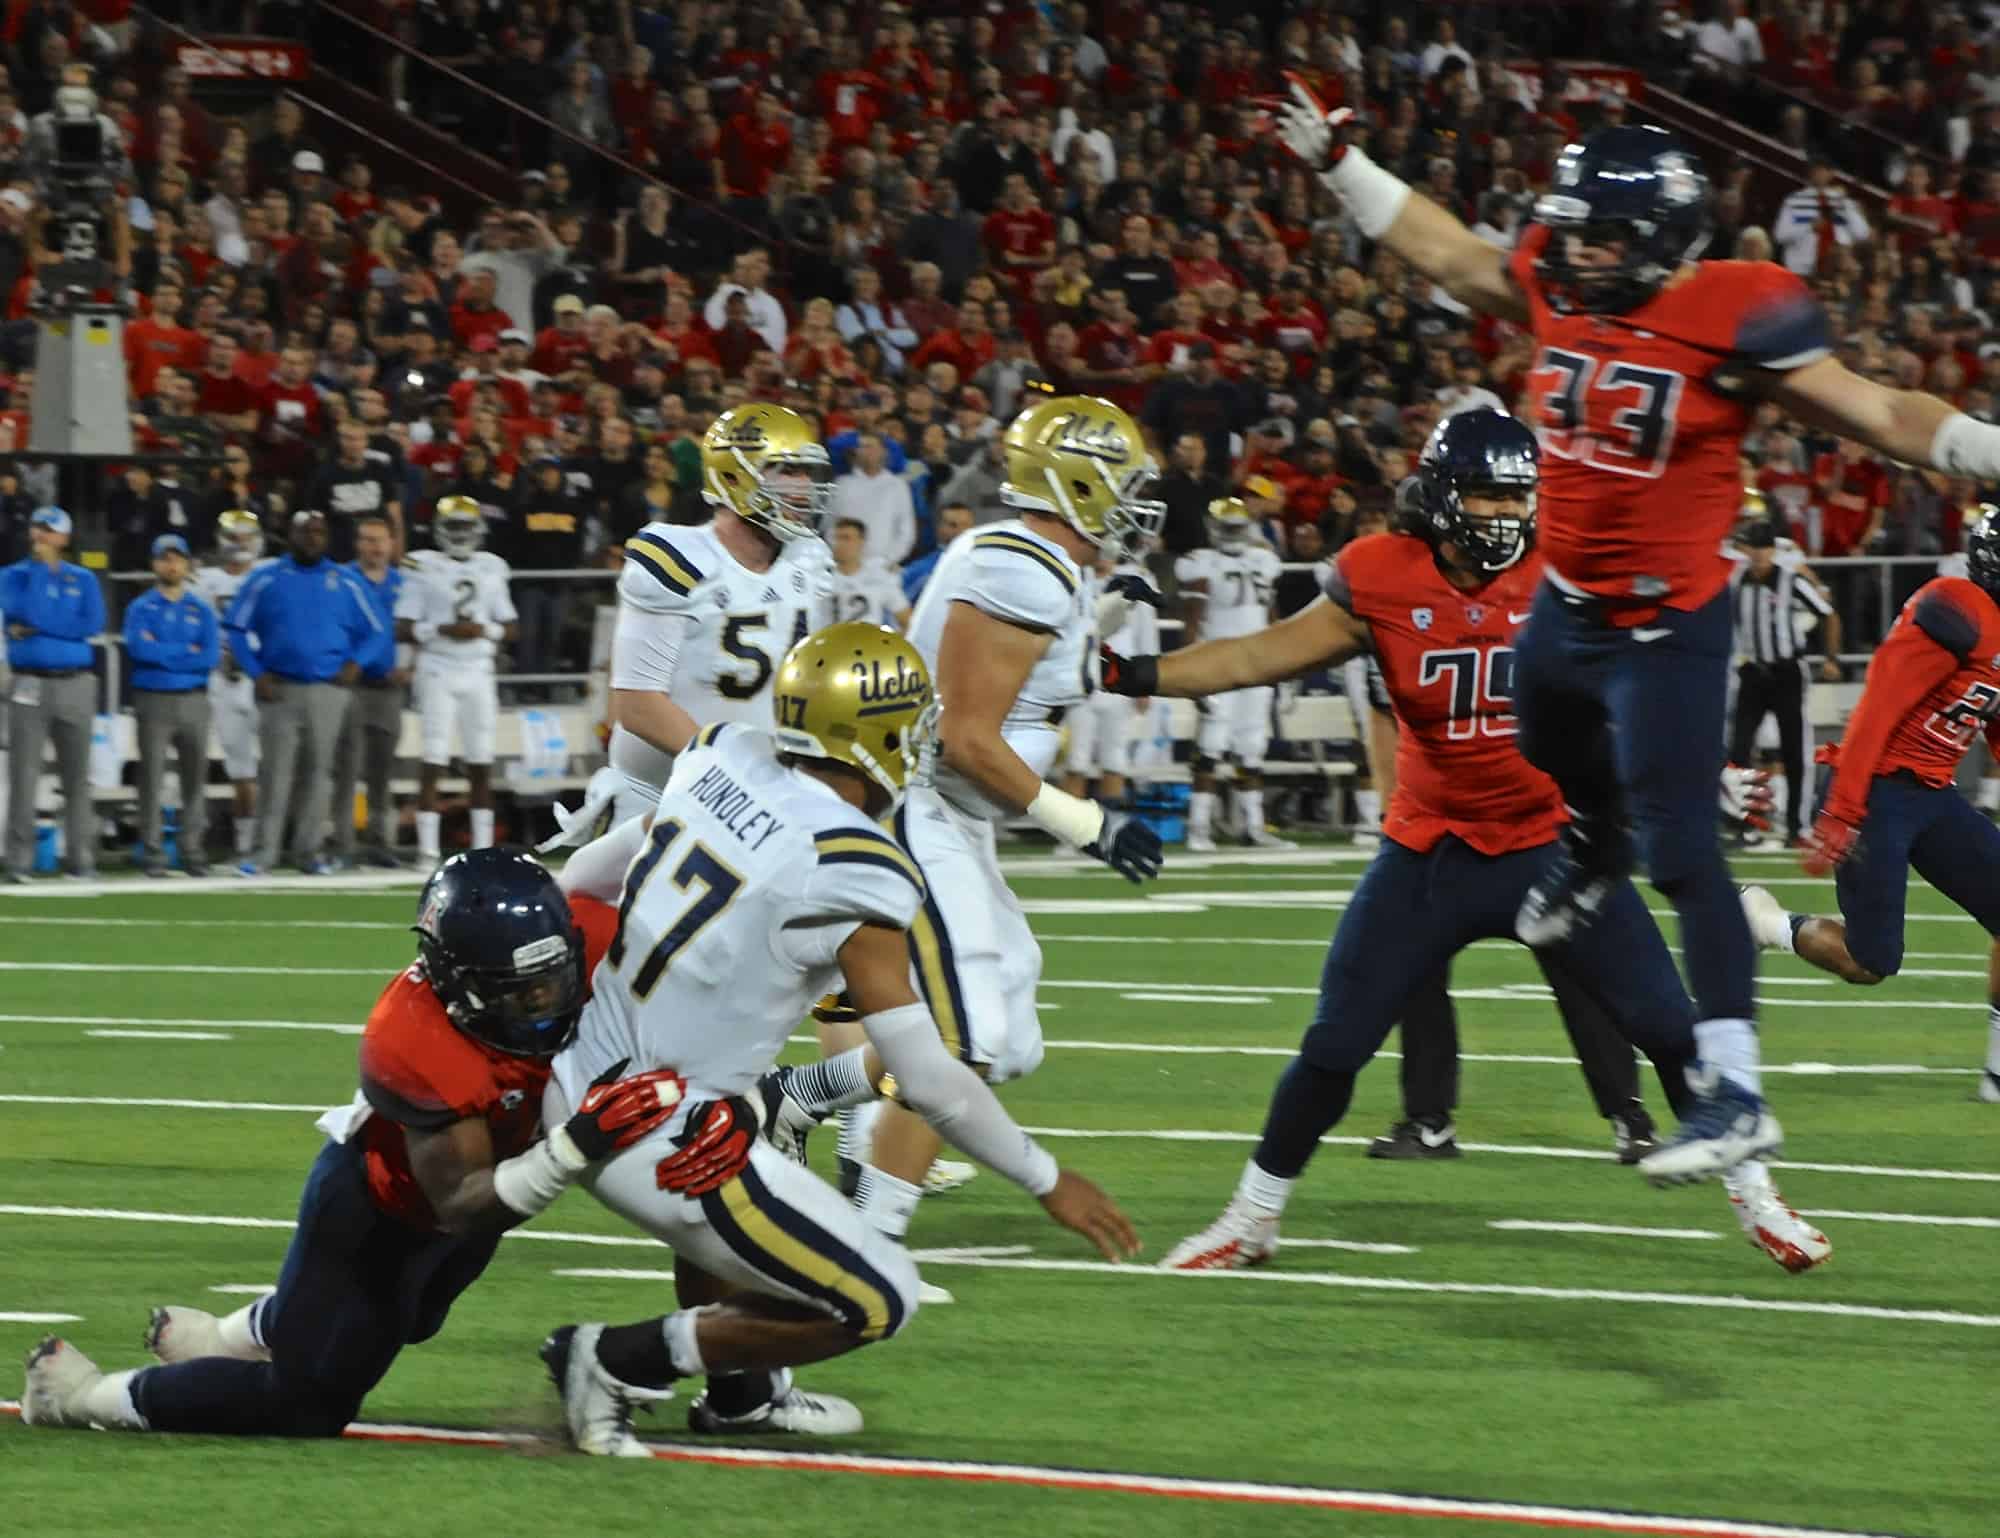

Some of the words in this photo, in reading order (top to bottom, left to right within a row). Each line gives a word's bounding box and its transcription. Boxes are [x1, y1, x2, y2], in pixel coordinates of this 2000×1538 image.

[1535, 346, 1685, 479] 33
[780, 694, 808, 730] 17
[688, 764, 785, 852] HUNDLEY
[607, 815, 749, 1003] 17
